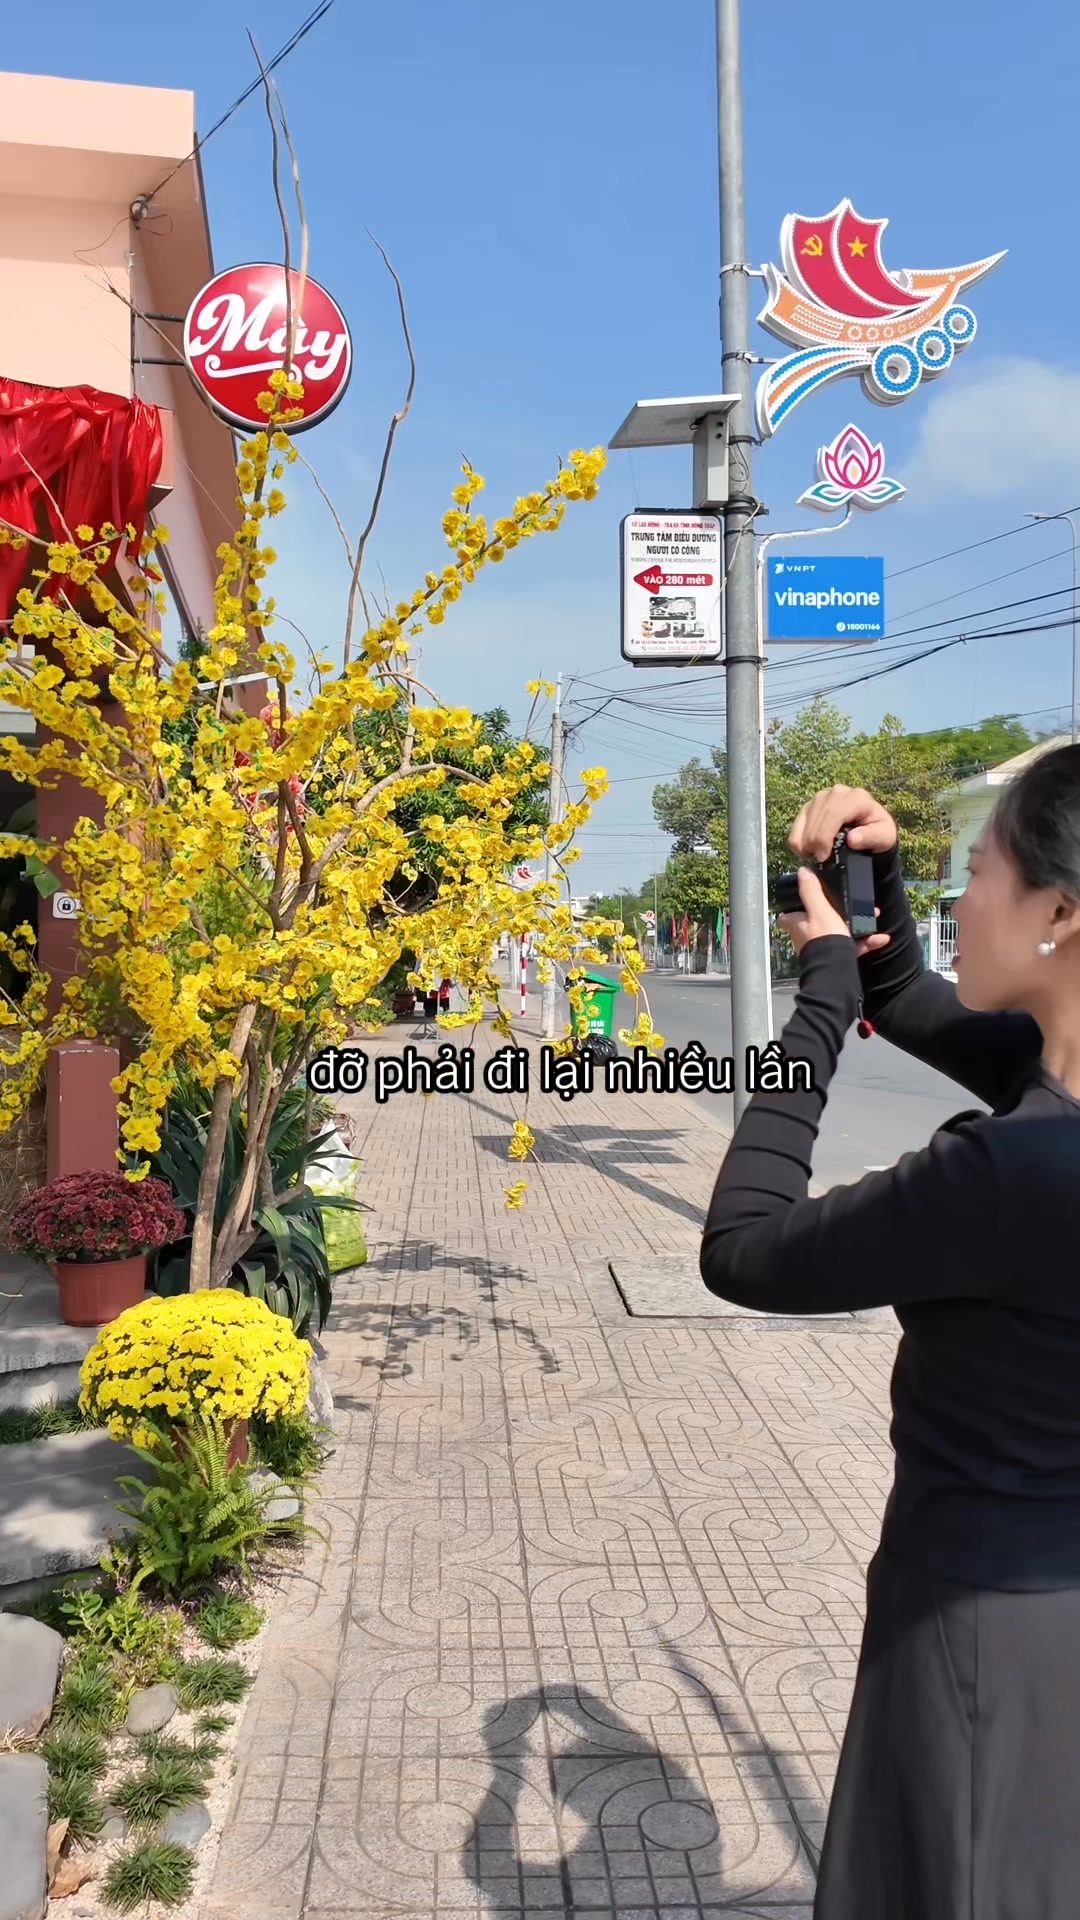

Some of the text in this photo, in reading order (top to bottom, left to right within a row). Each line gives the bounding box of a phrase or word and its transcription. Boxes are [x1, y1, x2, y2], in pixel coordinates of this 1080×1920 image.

[631, 532, 655, 541] TRUNG
[656, 531, 673, 542] TÂM
[646, 544, 669, 555] NGƯỜI
[681, 545, 701, 555] CÔNG
[643, 574, 706, 585] VÀO 280 mét
[774, 587, 881, 609] vinaphone
[847, 623, 880, 631] 18001166
